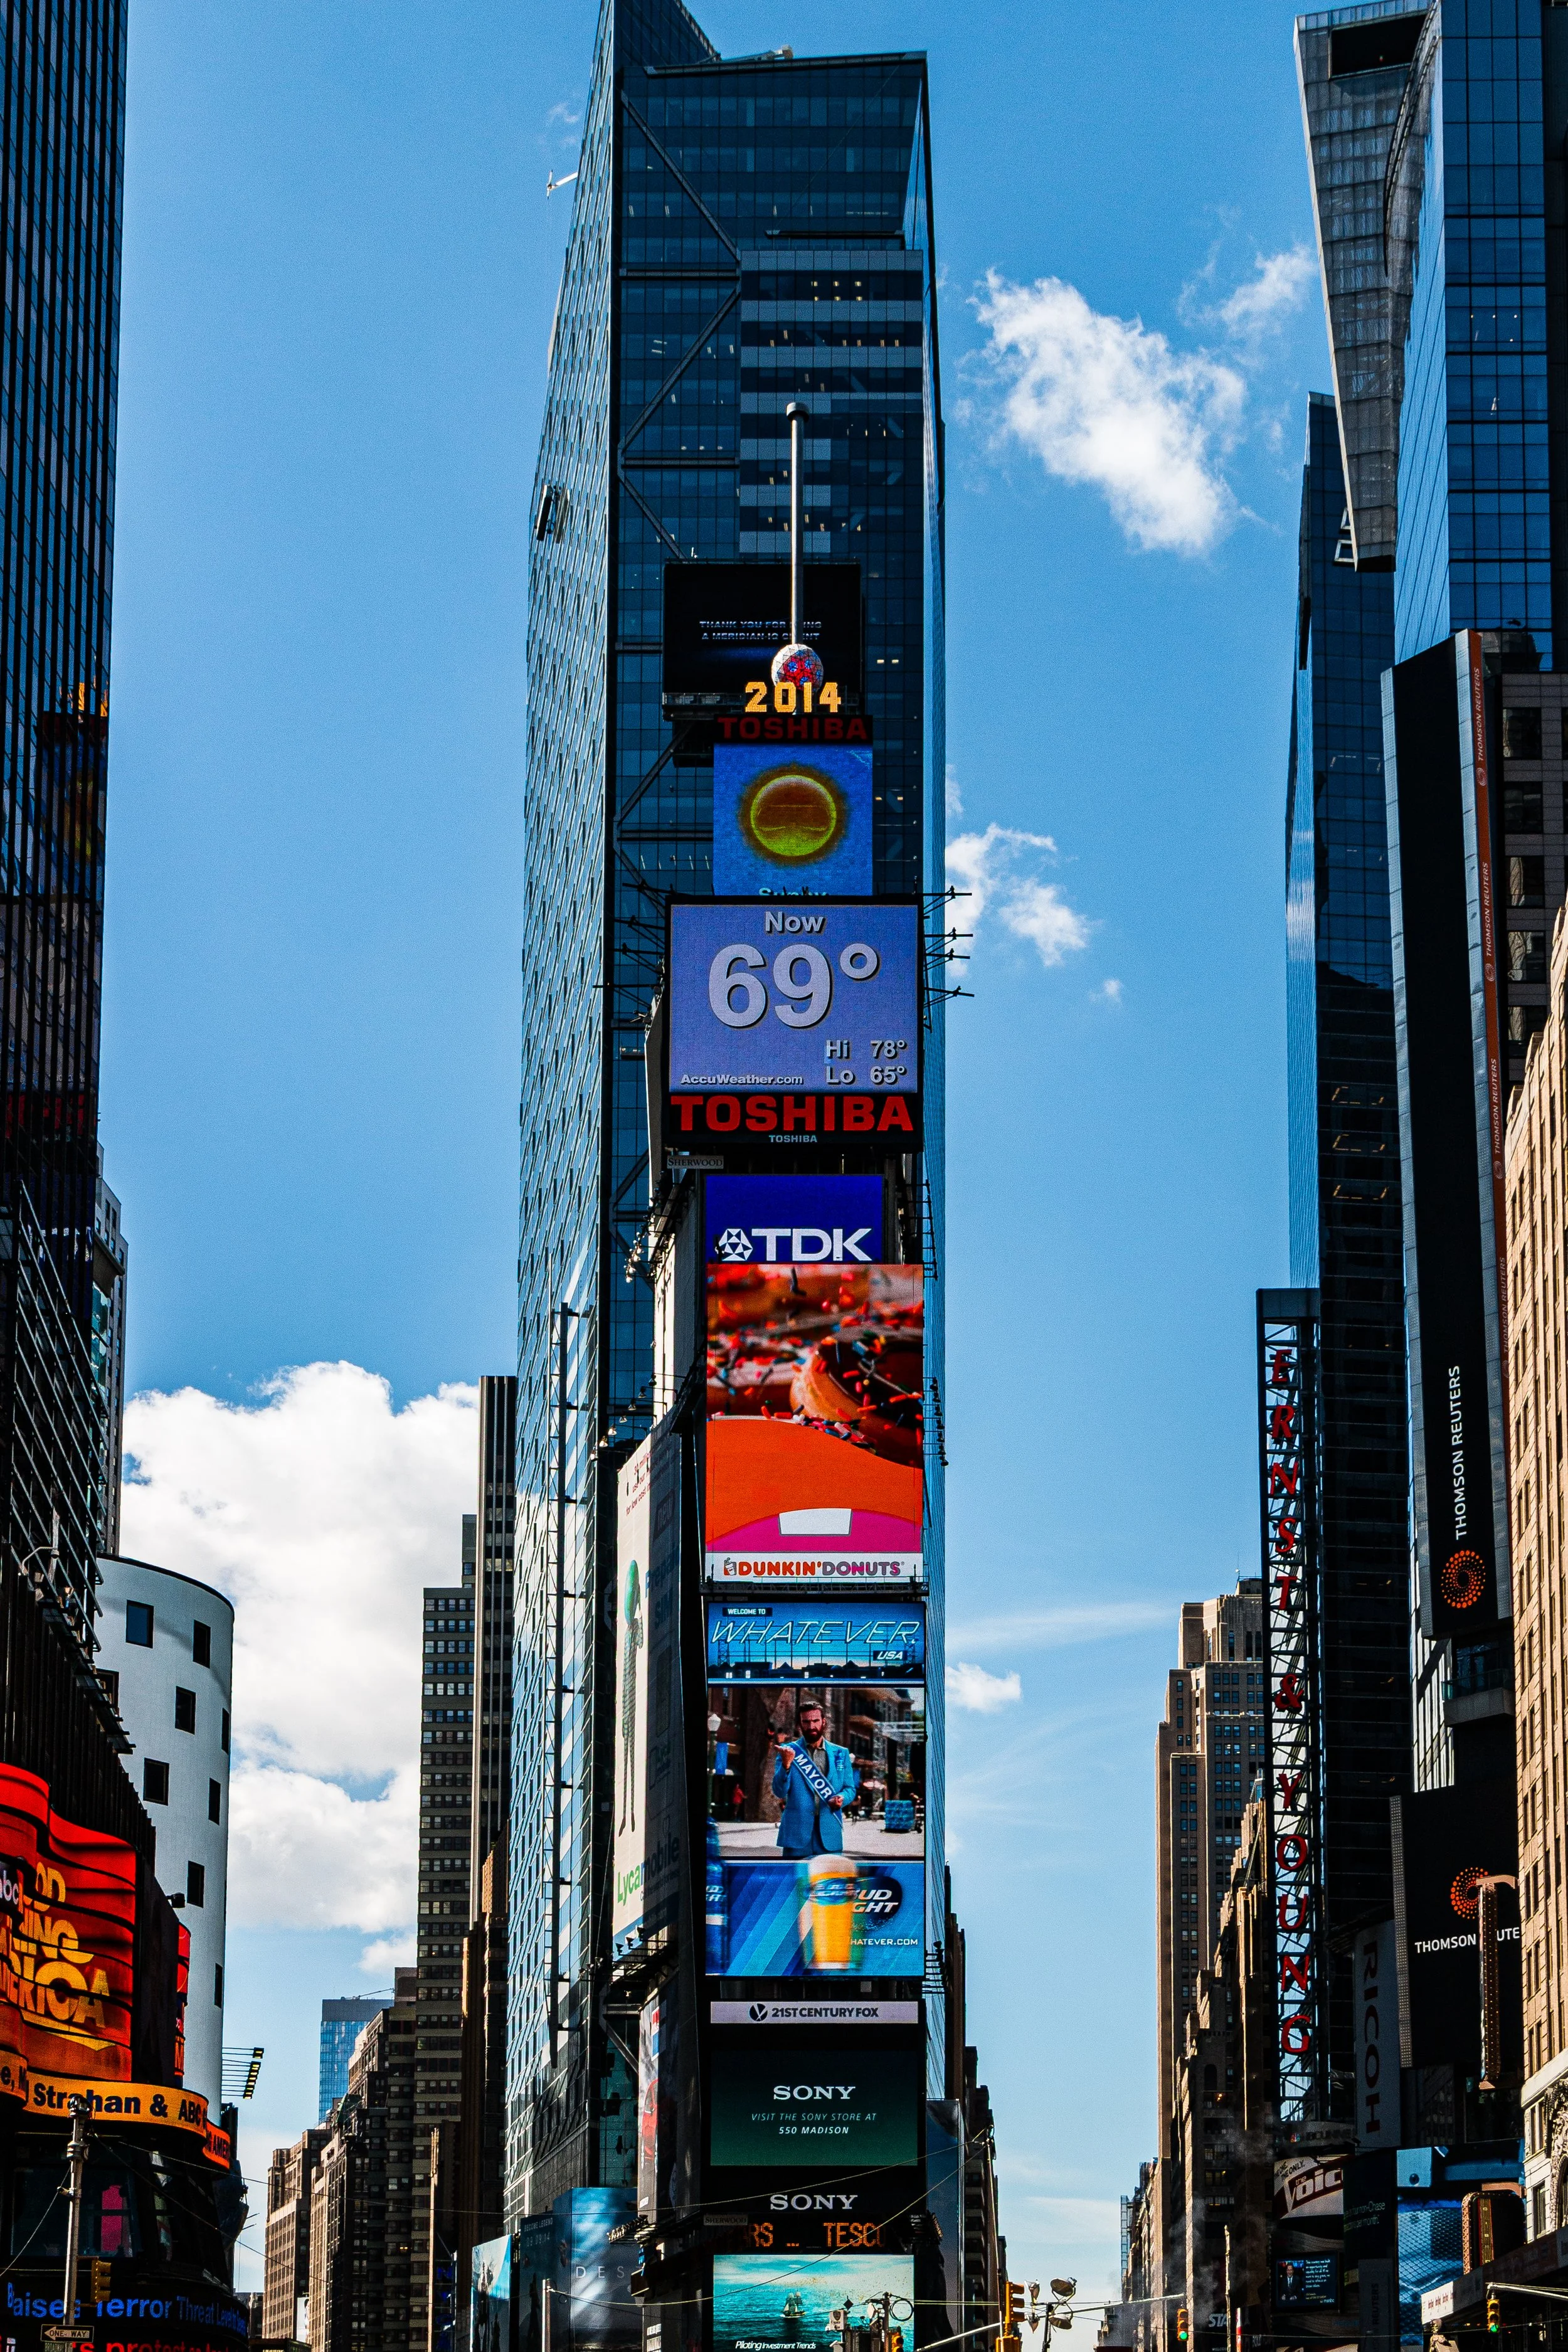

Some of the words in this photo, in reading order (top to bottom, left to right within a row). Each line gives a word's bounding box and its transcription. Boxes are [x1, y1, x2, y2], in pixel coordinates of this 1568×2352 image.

[744, 681, 841, 713] 2014
[1473, 666, 1482, 711] REUTERS
[718, 717, 868, 739] TOSHIBA
[1476, 712, 1484, 762] THOMSON
[1482, 861, 1490, 907] REUTERS
[765, 911, 825, 933] Now
[709, 943, 879, 1028] 69°
[825, 1040, 850, 1059] Hi
[870, 1040, 907, 1059] 78°
[681, 1074, 804, 1086] AccuWeather.com
[825, 1066, 855, 1084] Lo
[870, 1066, 907, 1084] 65°
[1490, 1058, 1499, 1104] REUTERS
[670, 1096, 914, 1131] TOSHIBA
[1492, 1104, 1501, 1155] THOMSON
[768, 1135, 818, 1143] TOSHIBA
[752, 1228, 872, 1261] TDK
[1499, 1256, 1508, 1303] REUTERS
[1501, 1303, 1509, 1355] THOMSON
[1448, 1365, 1459, 1446] REUTERS
[1270, 1348, 1298, 1611] ERNST
[1451, 1451, 1467, 1540] THOMSON
[877, 1651, 903, 1660] USA
[1274, 1673, 1303, 1712] &
[795, 1754, 832, 1799] MAYOR
[617, 1832, 679, 1906] Lycamobile
[852, 1902, 899, 1914] GHT
[857, 1889, 893, 1900] UD
[1276, 1773, 1312, 2053] YOUNG
[1414, 1934, 1476, 1954] THOMSON
[799, 2007, 855, 2018] CENTURY
[856, 2007, 879, 2018] FOX
[1363, 1941, 1380, 2134] RICOH
[773, 2085, 856, 2100] SONY
[150, 2094, 168, 2118] &
[178, 2099, 201, 2127] ABC
[770, 2195, 858, 2210] SONY
[1283, 2167, 1343, 2212] Voic
[575, 2265, 625, 2279] DES
[176, 2296, 215, 2325] Threat
[1371, 2282, 1379, 2325] REUTERS
[735, 2340, 761, 2351] Piloting
